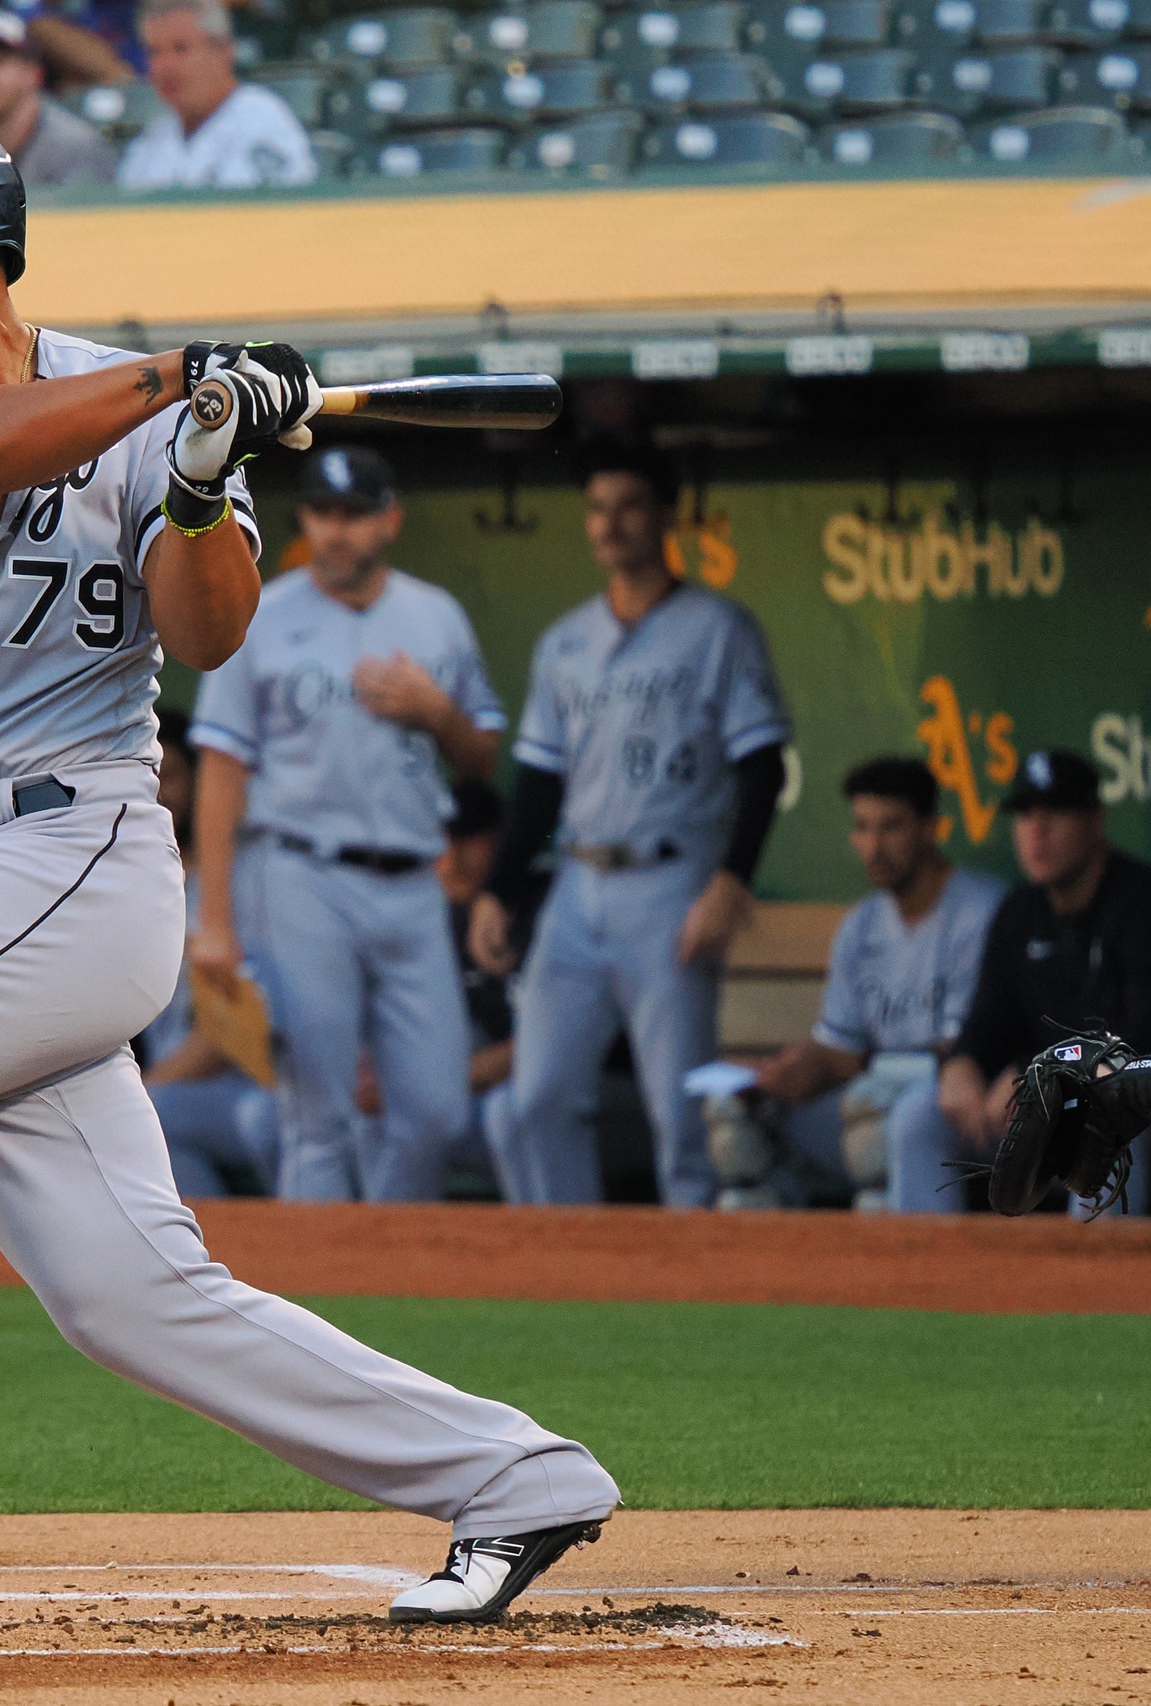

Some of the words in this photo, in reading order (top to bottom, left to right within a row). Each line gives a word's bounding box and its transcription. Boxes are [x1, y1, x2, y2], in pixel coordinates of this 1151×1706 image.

[203, 398, 222, 420] 79
[823, 512, 1063, 604] StubHub
[2, 556, 126, 653] 79
